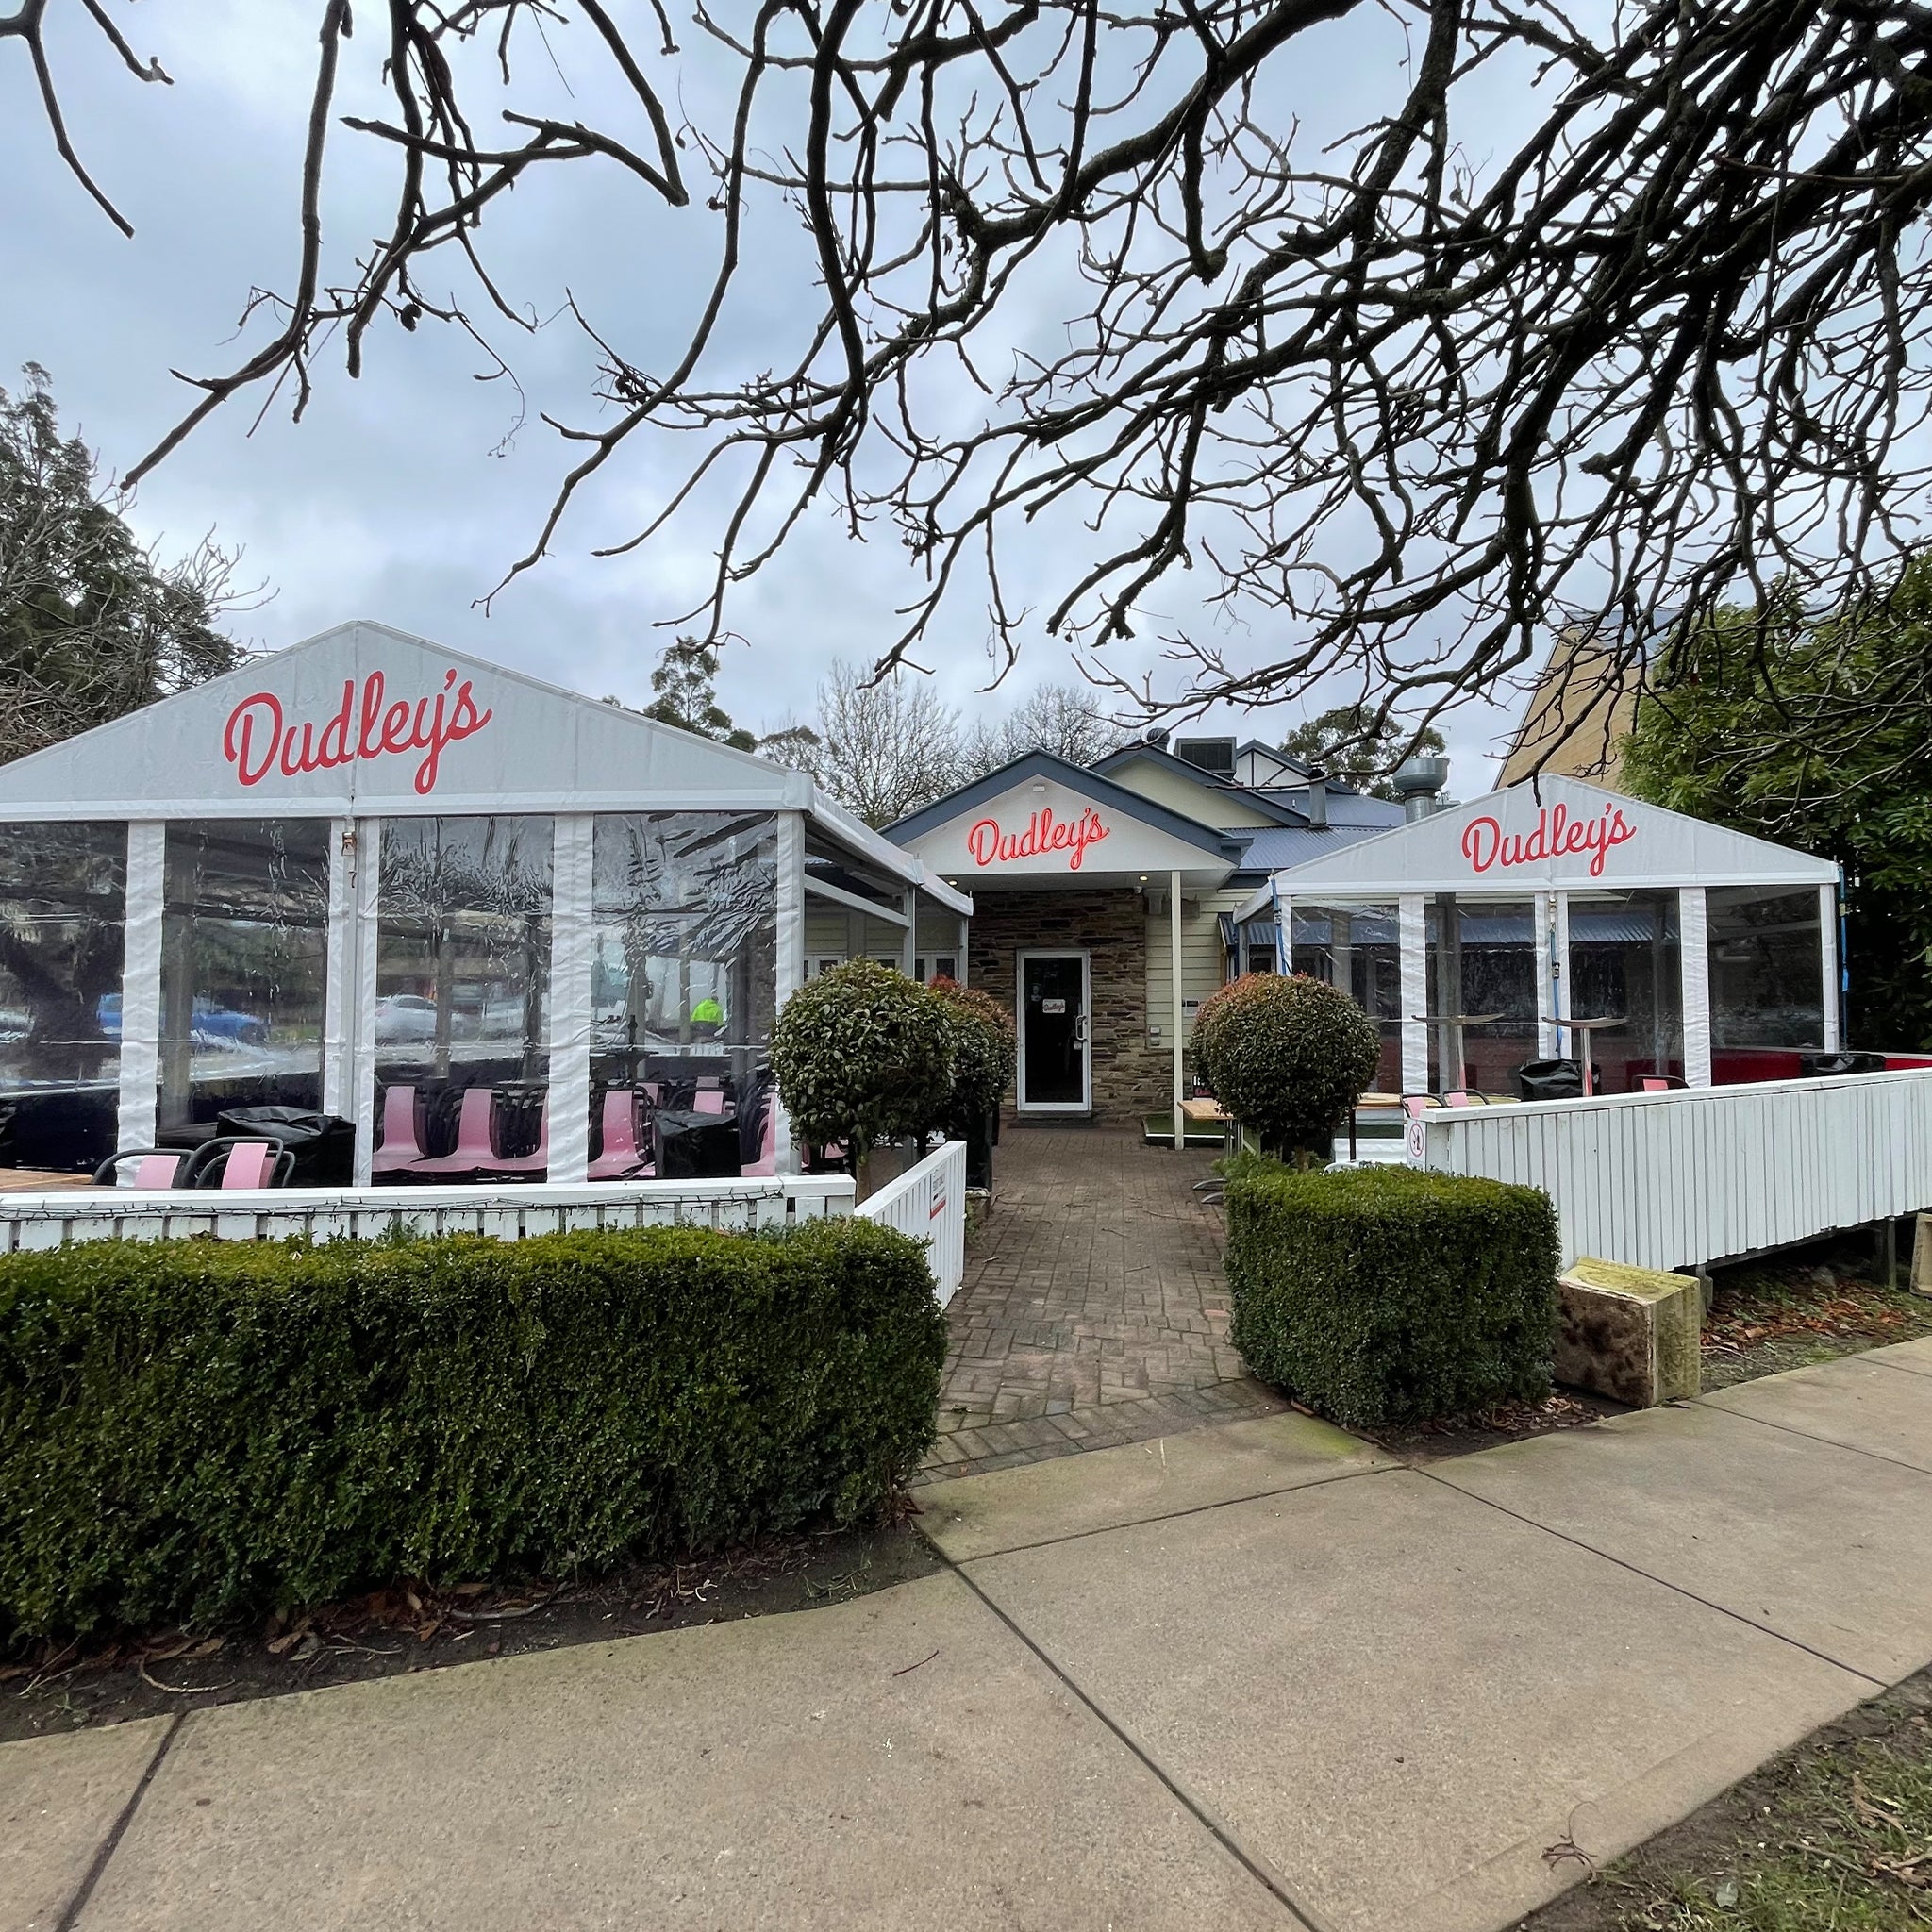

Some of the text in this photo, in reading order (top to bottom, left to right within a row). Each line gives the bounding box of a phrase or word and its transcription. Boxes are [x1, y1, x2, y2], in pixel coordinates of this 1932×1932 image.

[225, 670, 491, 794] Dudley's
[969, 808, 1108, 870] Dudley's
[1461, 803, 1636, 876] Dudley's
